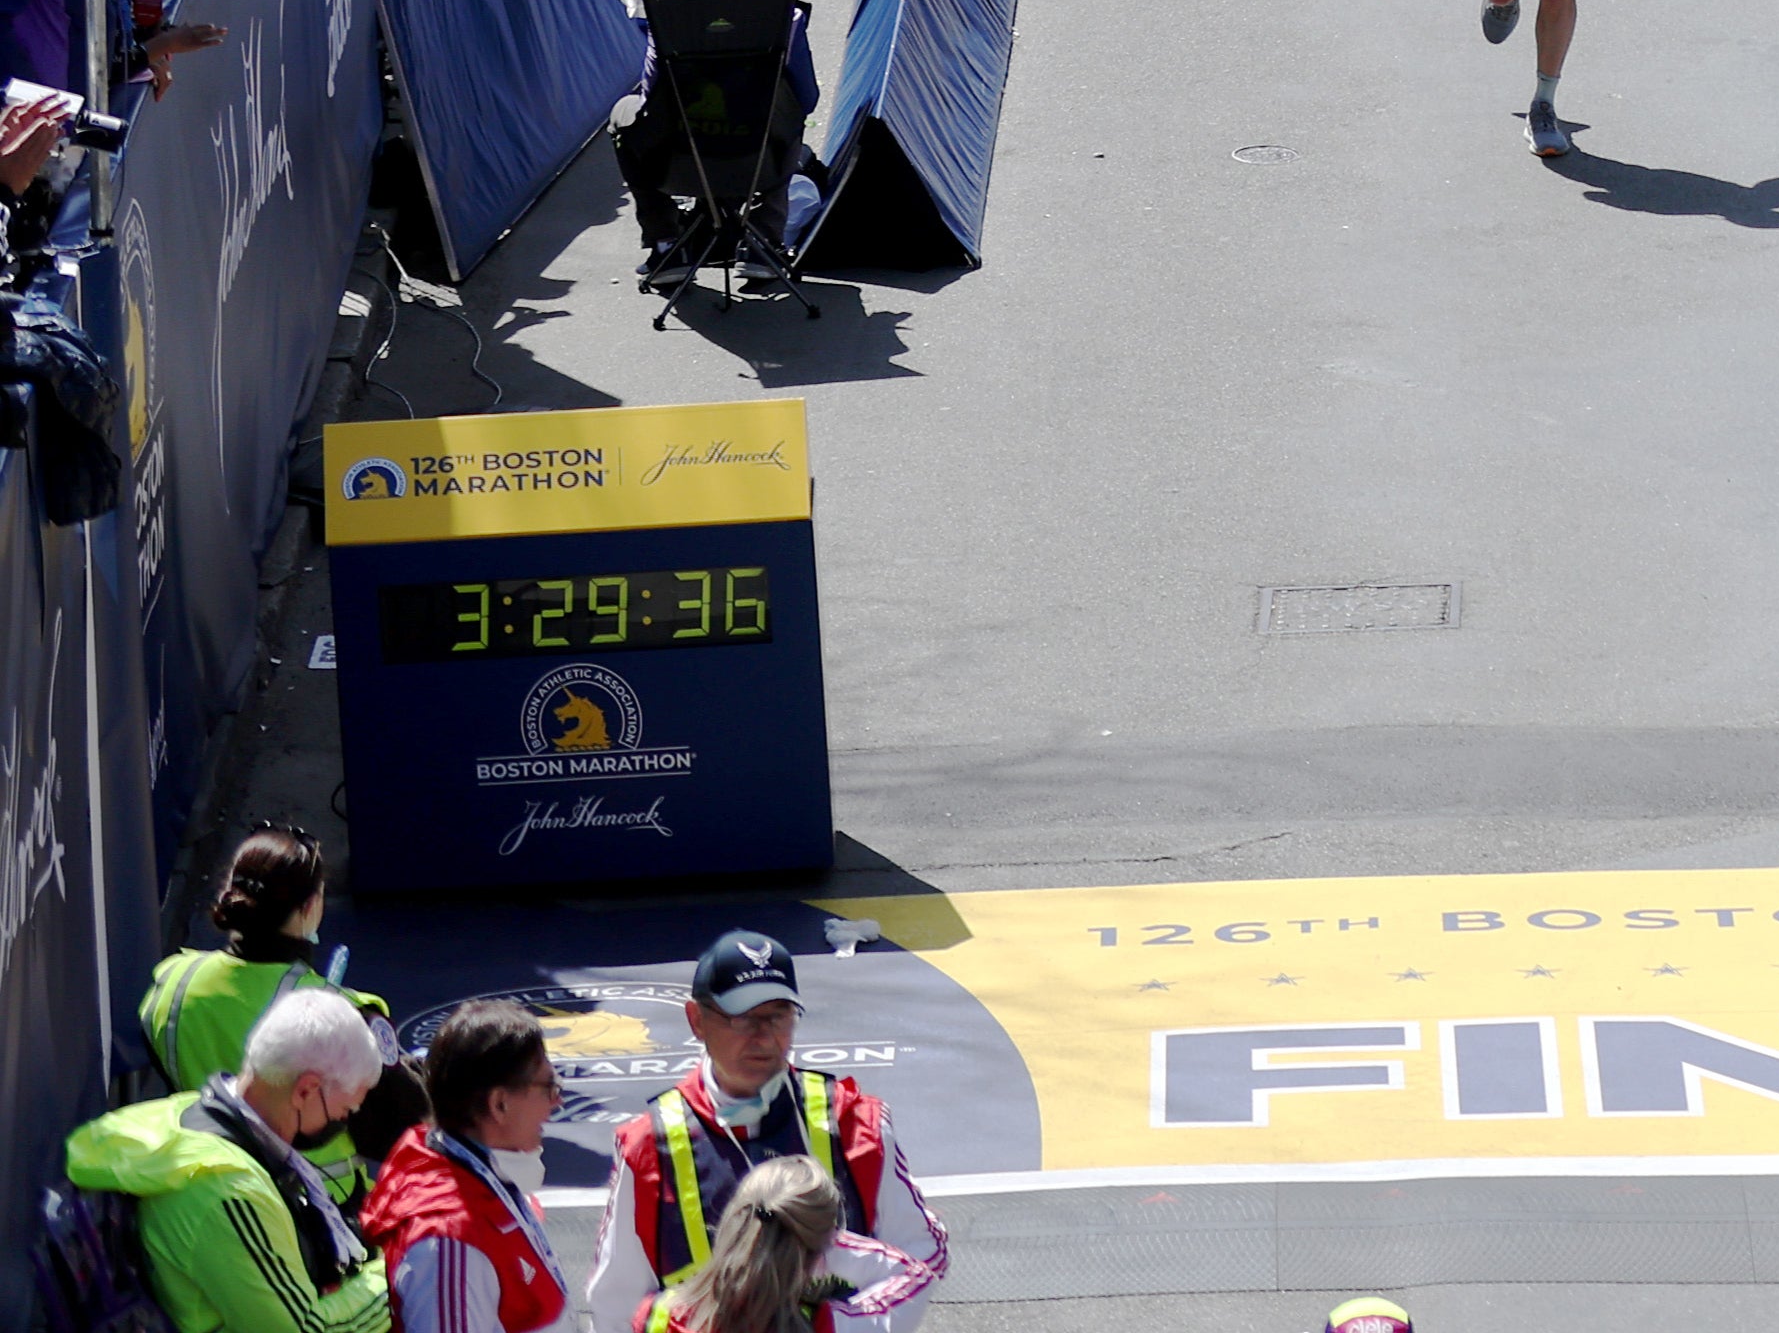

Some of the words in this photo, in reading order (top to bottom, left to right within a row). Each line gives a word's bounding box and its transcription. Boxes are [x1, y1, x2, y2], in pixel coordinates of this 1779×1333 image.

[410, 453, 476, 475] 126TH
[482, 448, 604, 472] BOSTON
[640, 441, 704, 487] John
[698, 439, 793, 471] Hancock
[413, 470, 605, 498] MARATHON
[450, 568, 766, 652] 3:29:36
[525, 698, 542, 751] BOSTON
[536, 667, 594, 699] ATHLETIC
[593, 670, 638, 744] ASSOCIATION
[476, 759, 564, 780] BOSTON
[569, 751, 692, 776] MARATHON
[499, 799, 574, 856] John
[566, 795, 674, 837] Hancock
[1087, 918, 1384, 949] 126TH
